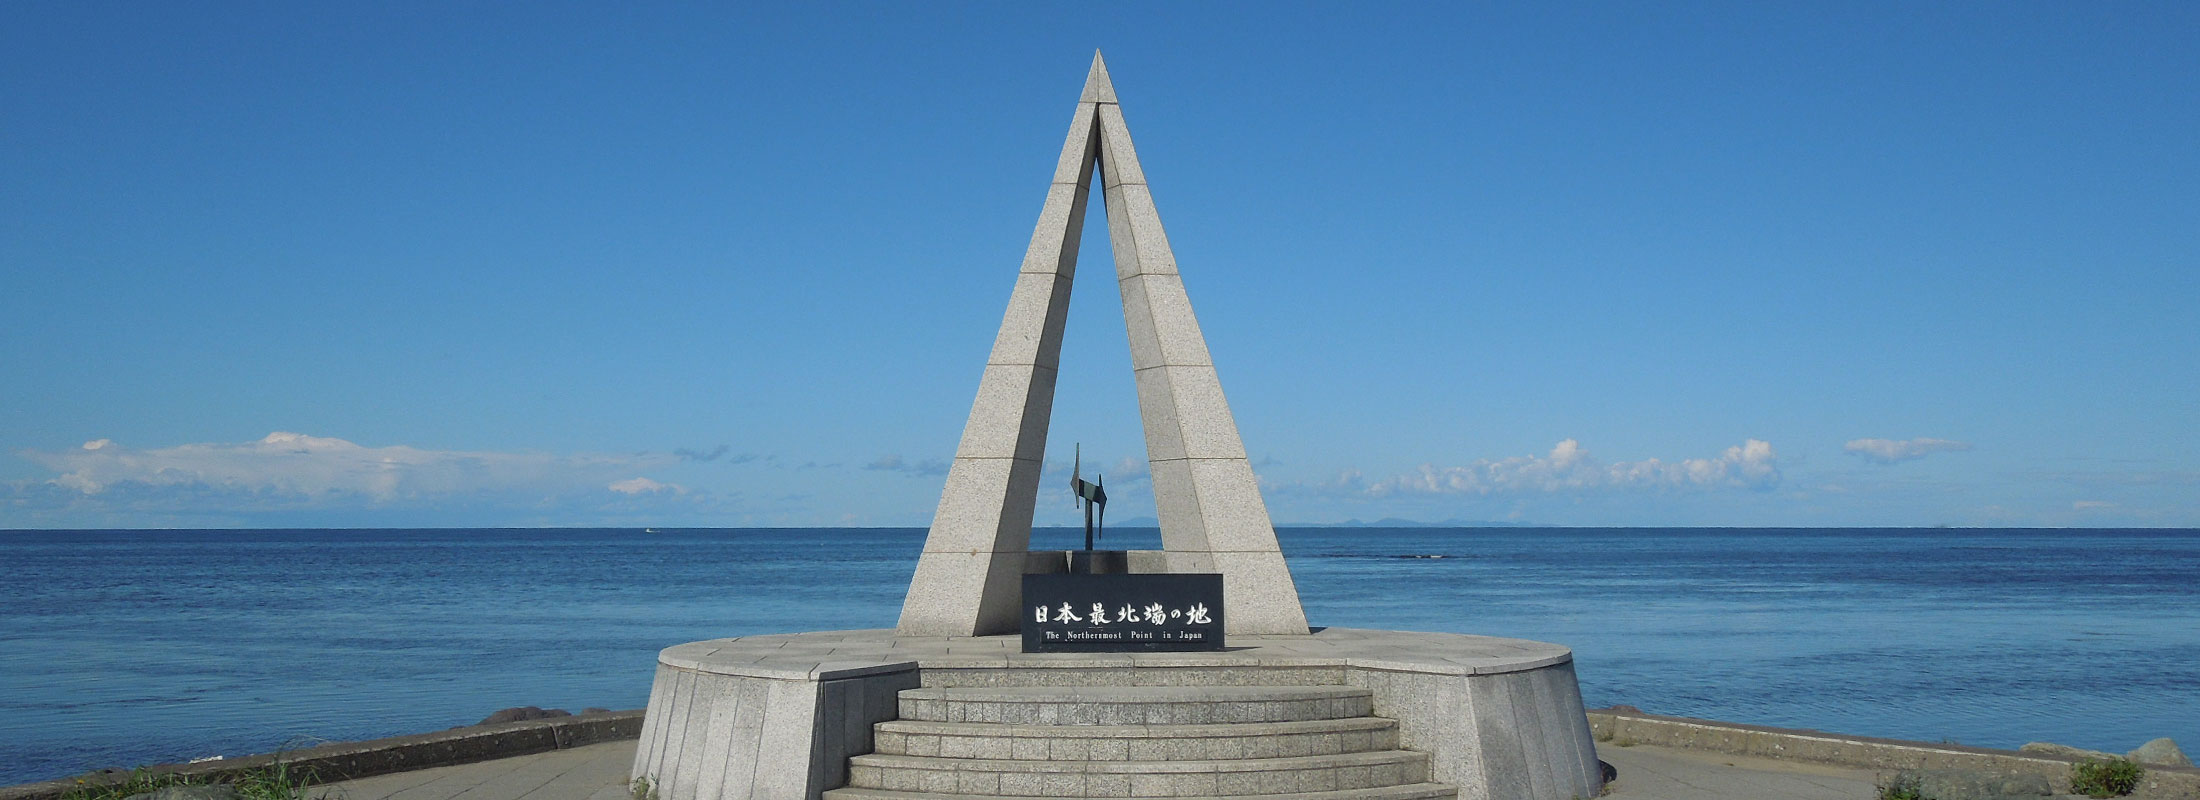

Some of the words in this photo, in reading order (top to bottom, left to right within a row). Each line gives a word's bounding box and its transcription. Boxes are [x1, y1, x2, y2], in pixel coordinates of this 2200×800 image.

[1035, 602, 1212, 625] 日本最北端の地
[1045, 631, 1060, 639] The
[1131, 630, 1153, 639] Point
[1163, 630, 1171, 639] in
[1179, 630, 1202, 641] Japan
